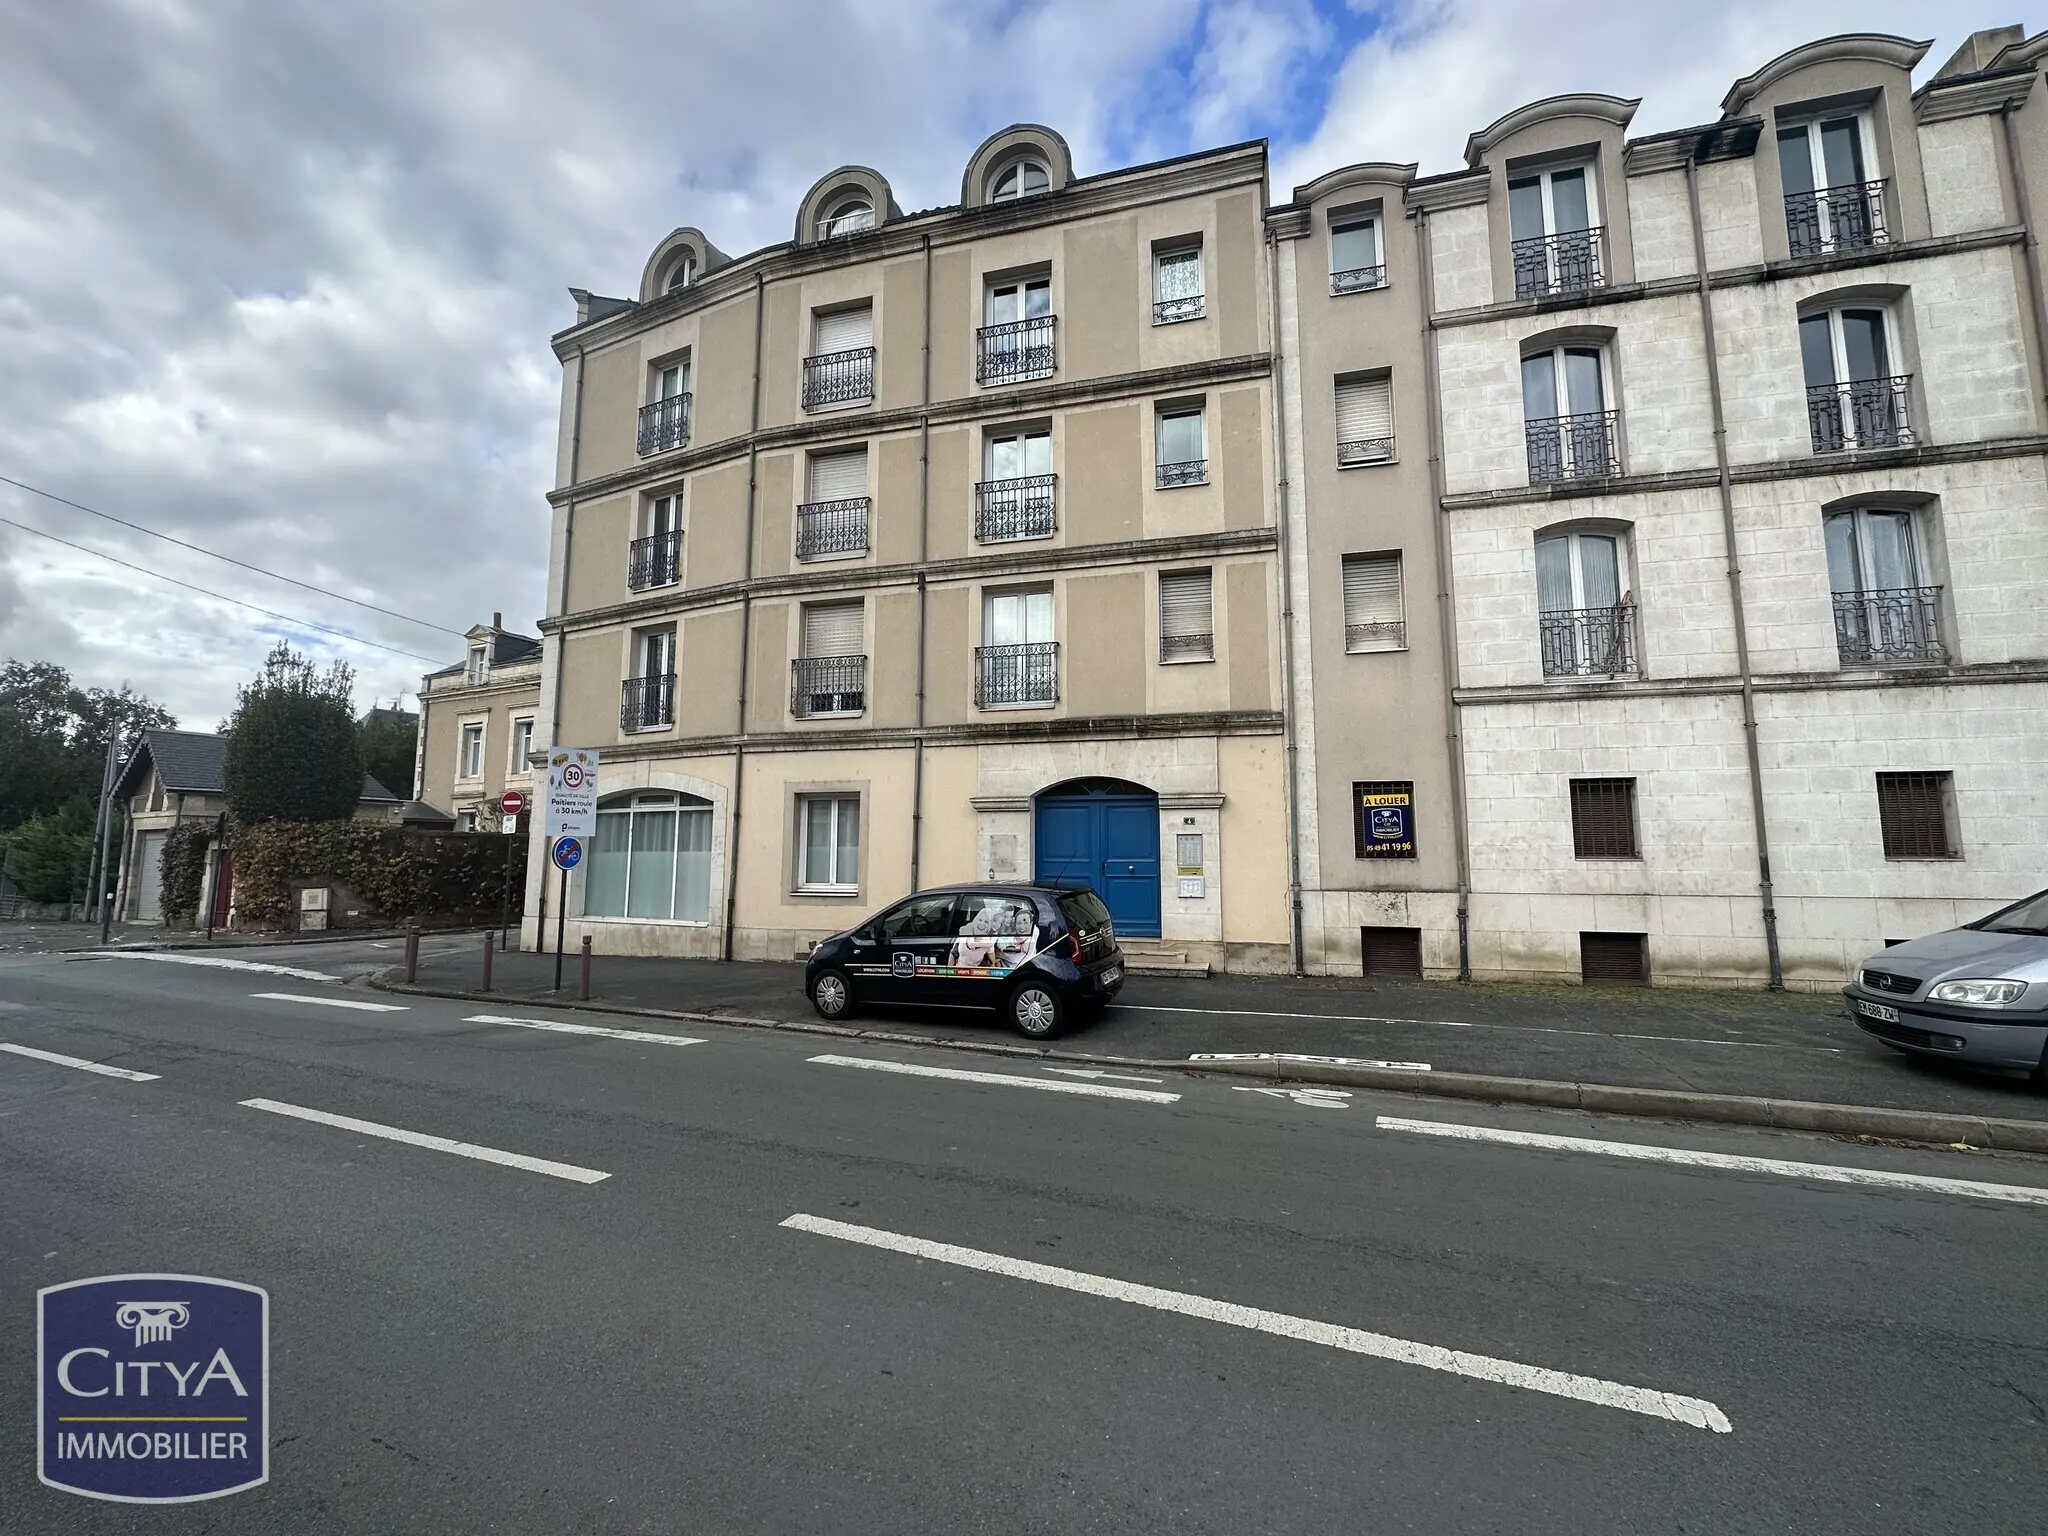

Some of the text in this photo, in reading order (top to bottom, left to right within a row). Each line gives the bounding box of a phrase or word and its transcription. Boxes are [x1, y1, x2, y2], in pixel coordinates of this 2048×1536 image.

[567, 771, 579, 781] 30
[1364, 796, 1406, 805] À LOUER
[1392, 842, 1400, 850] 19
[1402, 842, 1412, 850] 96
